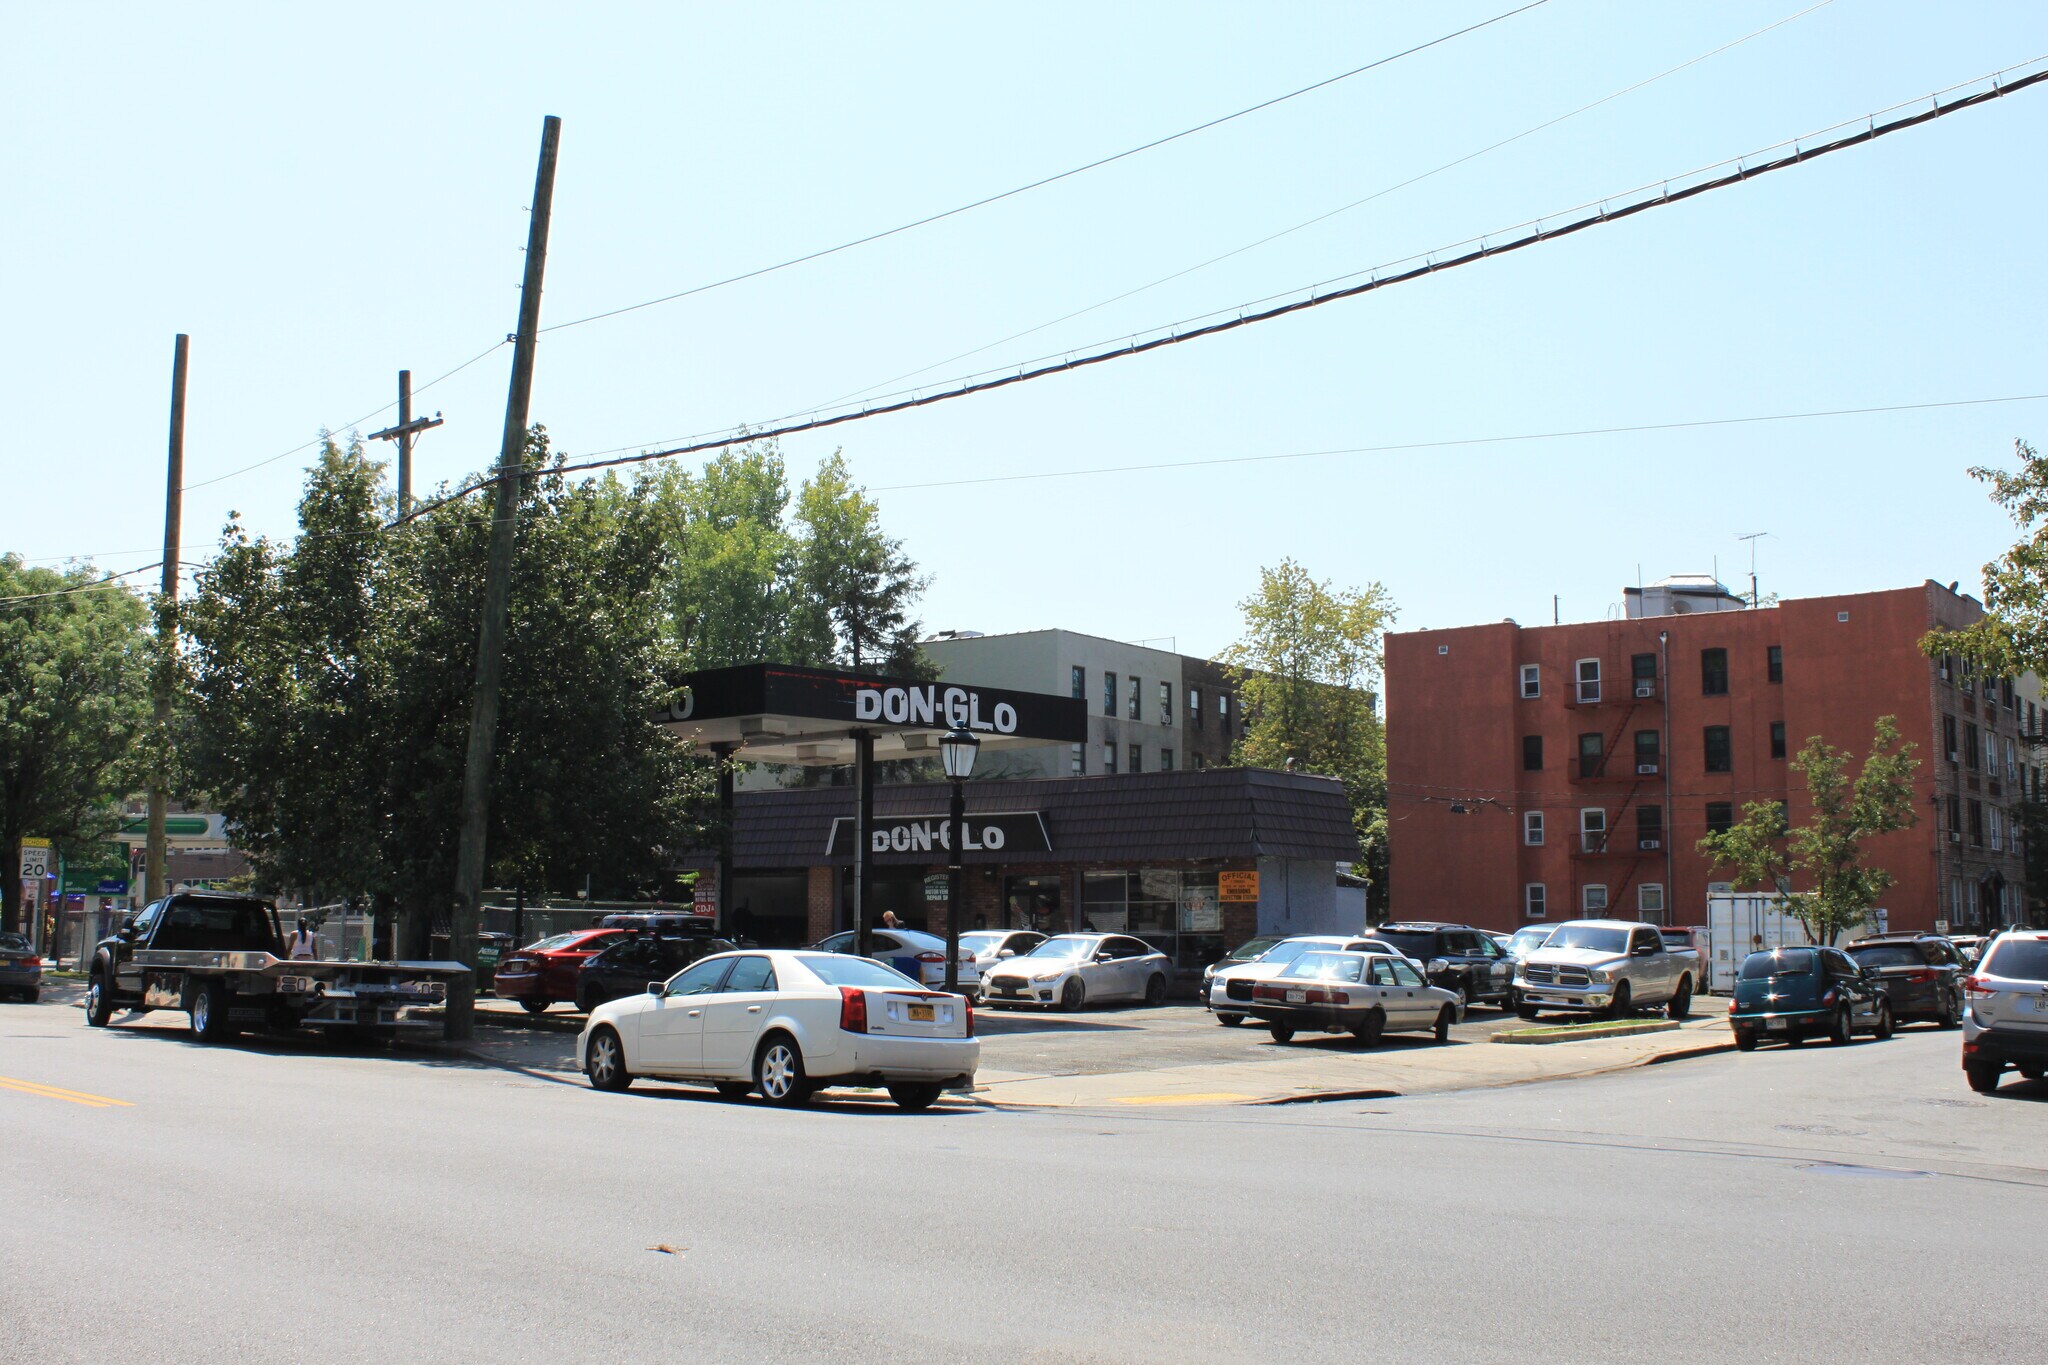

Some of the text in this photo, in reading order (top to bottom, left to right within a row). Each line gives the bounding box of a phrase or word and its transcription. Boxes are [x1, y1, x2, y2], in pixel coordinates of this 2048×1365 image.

[856, 686, 1018, 734] DON-GLO
[22, 863, 45, 876] 20
[1221, 872, 1256, 881] OFFICIAL
